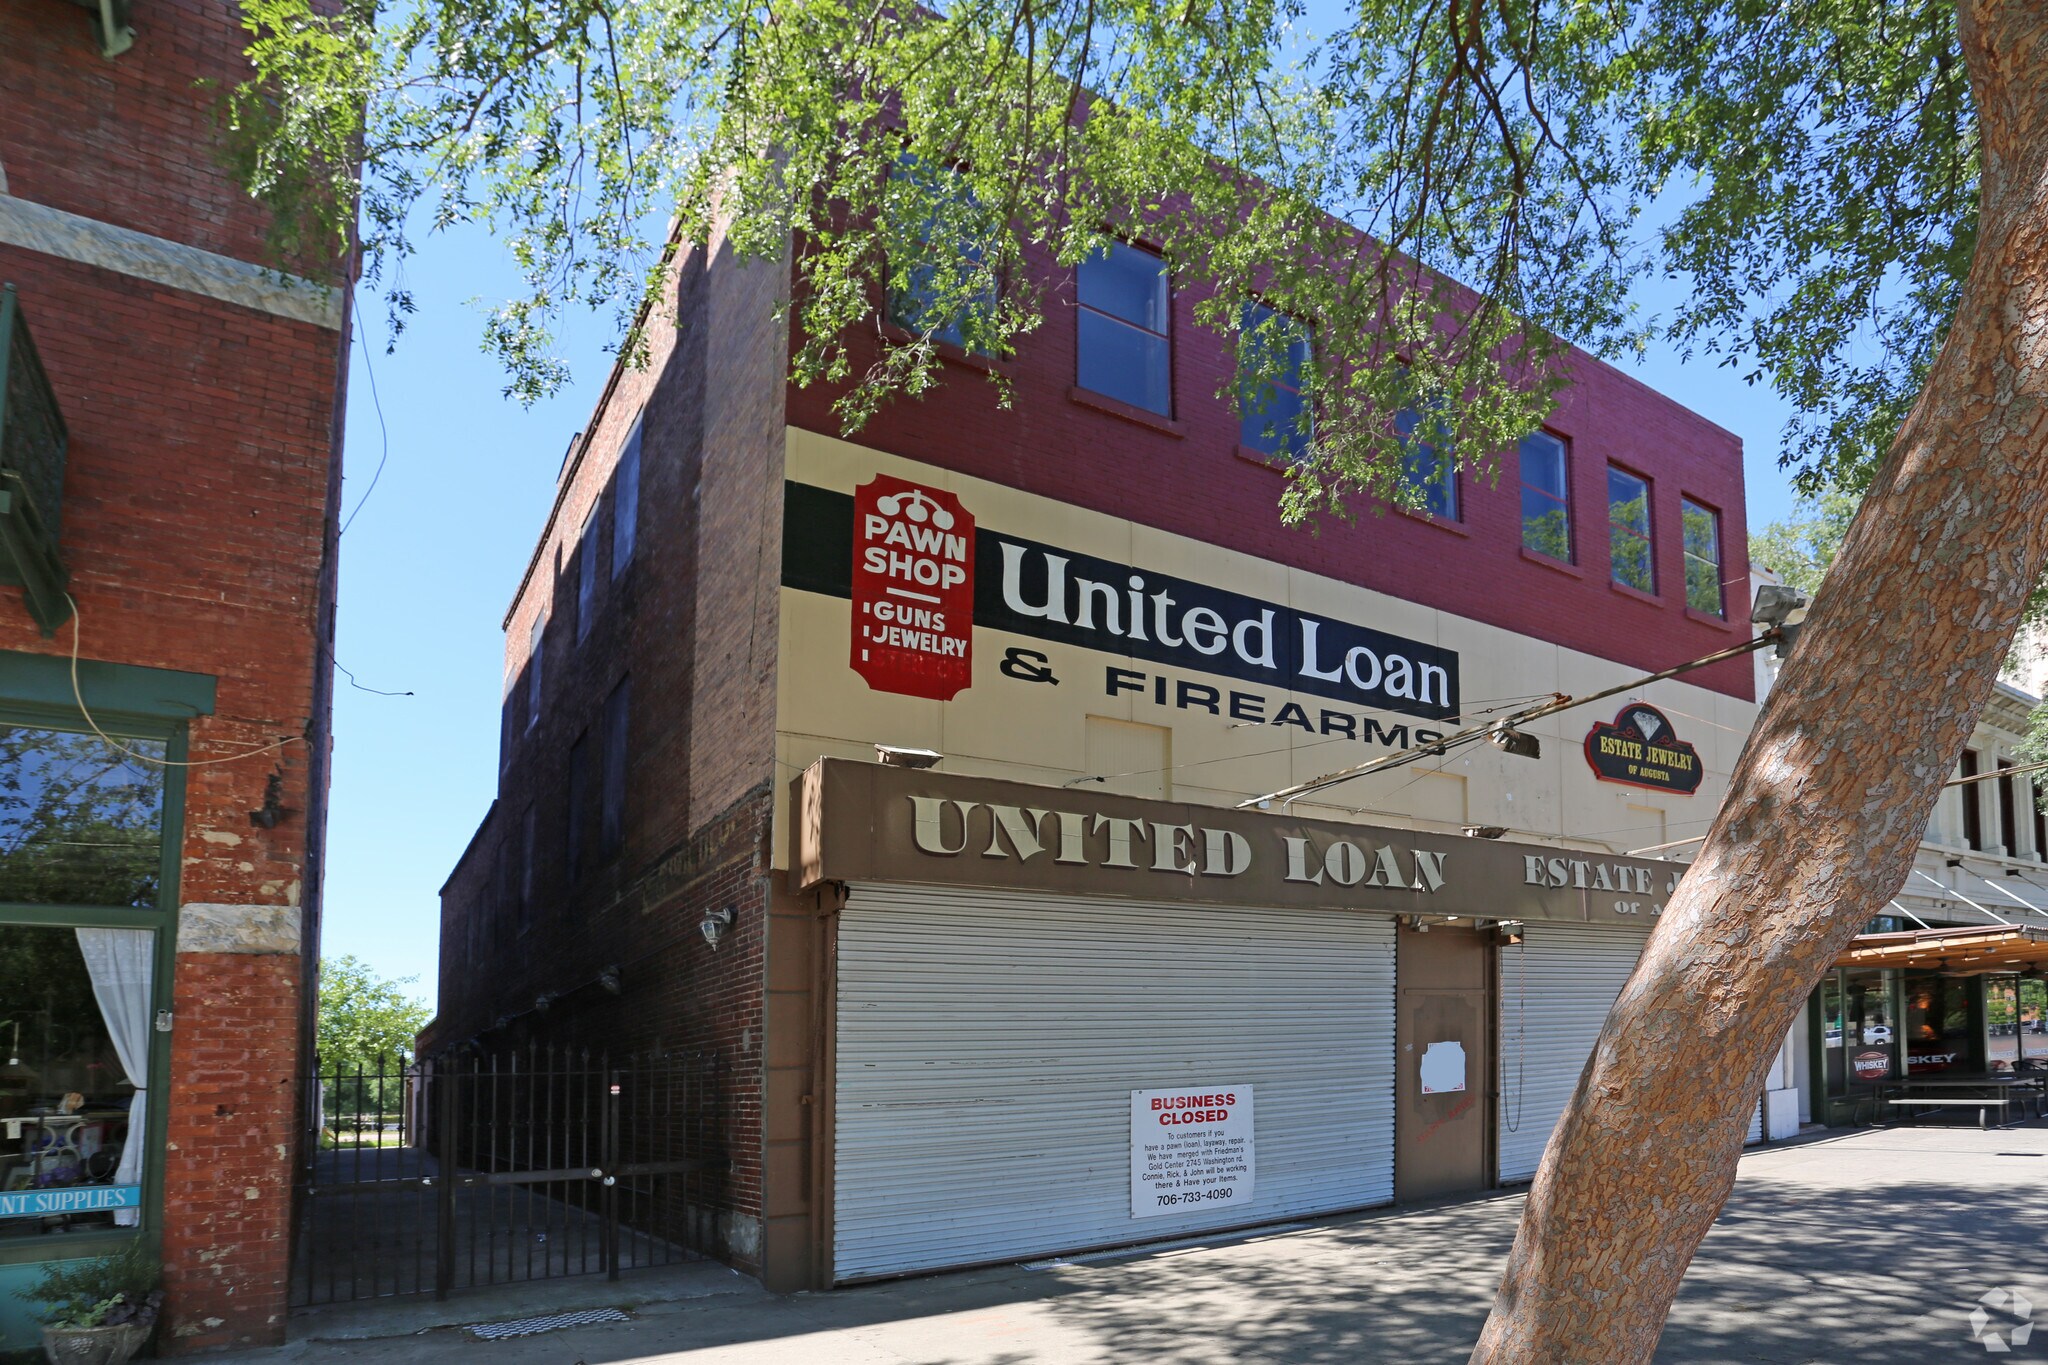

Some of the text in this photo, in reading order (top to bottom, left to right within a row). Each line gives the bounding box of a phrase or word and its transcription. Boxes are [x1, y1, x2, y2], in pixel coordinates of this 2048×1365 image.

[864, 513, 966, 562] PAWN
[862, 546, 966, 590] SHOP
[873, 601, 946, 632] GUNS
[999, 541, 1451, 708] United Loan
[872, 625, 968, 658] JEWELRY
[999, 647, 1446, 756] & FIREARMS
[1600, 735, 1693, 771] ESTATE JEWELRY
[1628, 764, 1670, 781] OF AUGUSTA
[907, 795, 1447, 893] UNITED LOAN
[1523, 854, 1653, 896] ESTATE
[1854, 1058, 1889, 1072] WHISKEY
[1906, 1053, 1957, 1065] SKEY
[1151, 1093, 1236, 1111] BUSINESS
[1159, 1109, 1228, 1125] CLOSED
[1168, 1132, 1175, 1140] To
[1176, 1131, 1206, 1140] customers
[1214, 1130, 1224, 1138] you
[1144, 1143, 1159, 1152] have
[1166, 1143, 1182, 1151] pawn
[1147, 1146, 1244, 1161] We have merged with Friedman's
[1148, 1162, 1163, 1171] Gold
[1164, 1160, 1184, 1169] Center
[1186, 1158, 1202, 1167] 2745
[1203, 1155, 1235, 1166] Washington
[1183, 1169, 1188, 1177] &
[1190, 1168, 1204, 1177] John
[1206, 1166, 1216, 1174] will
[1226, 1164, 1248, 1173] working
[1155, 1180, 1173, 1189] there
[1183, 1177, 1200, 1187] Have
[1202, 1177, 1217, 1186] your
[35, 1188, 127, 1212] SUPPLIES
[1157, 1187, 1233, 1207] 706-733-4090
